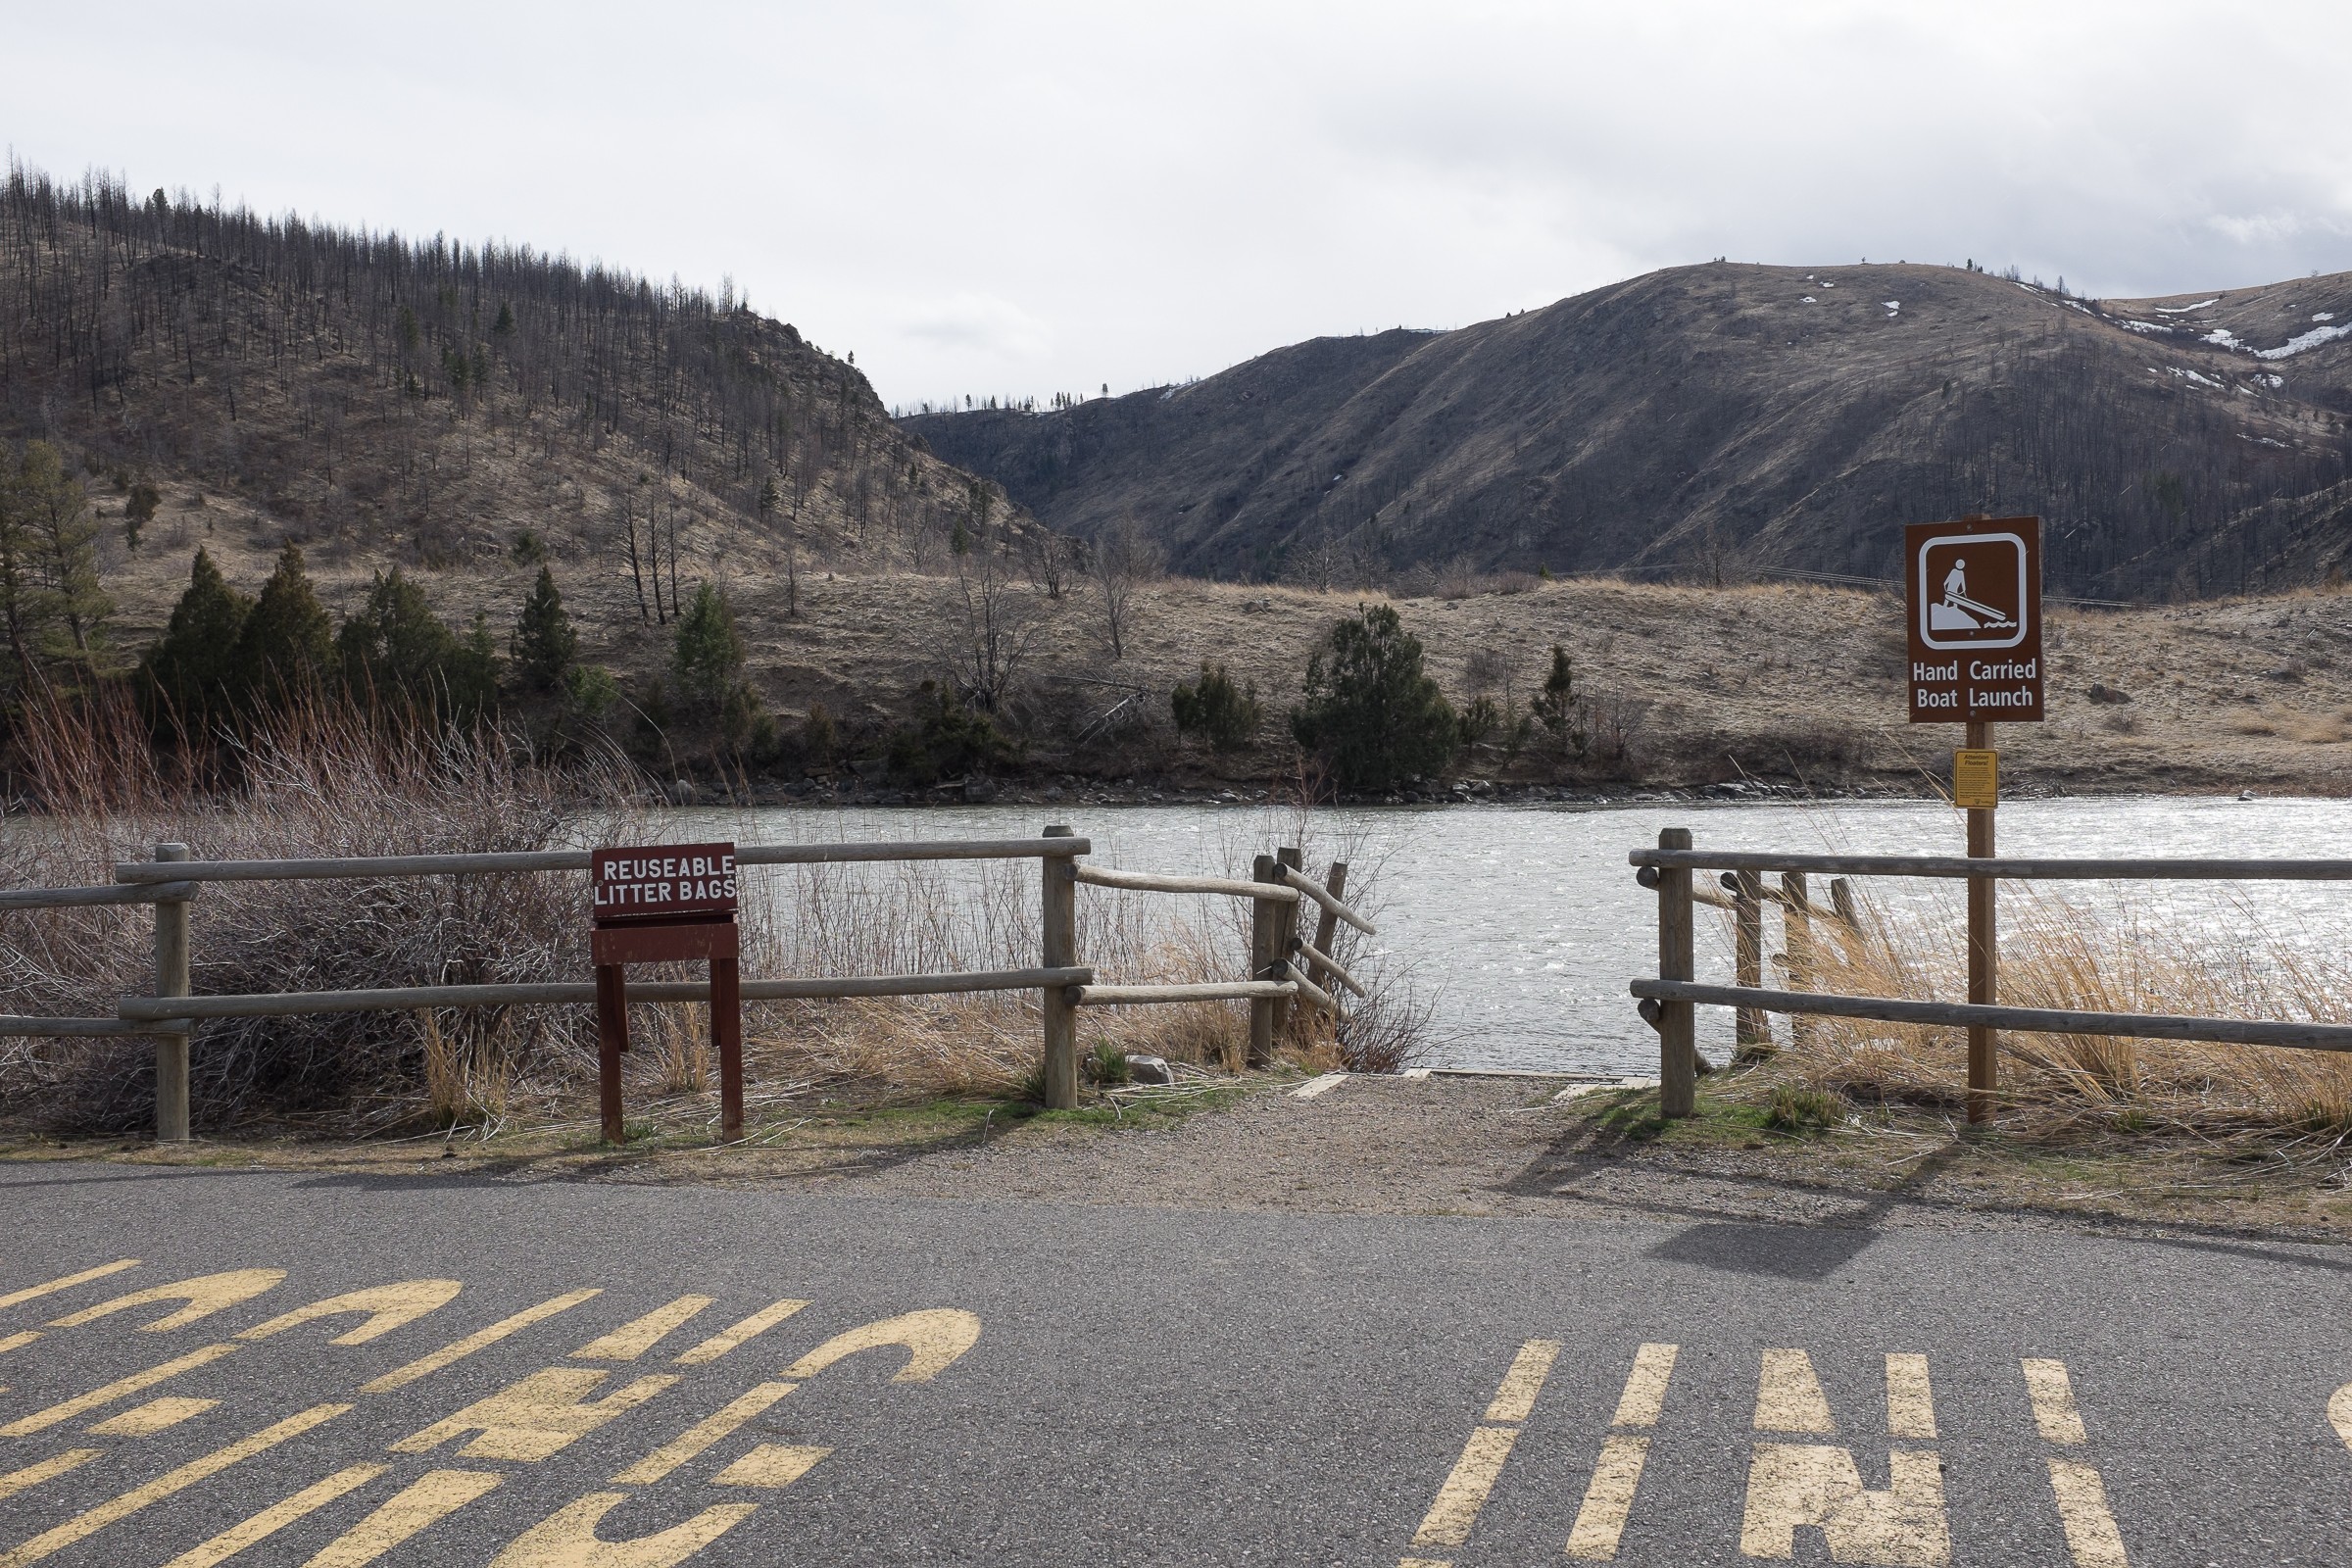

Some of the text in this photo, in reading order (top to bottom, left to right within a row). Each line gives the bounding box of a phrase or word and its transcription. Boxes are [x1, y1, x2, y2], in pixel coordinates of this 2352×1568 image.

[1913, 658, 2036, 681] Hand Carried
[1917, 685, 2034, 708] Boat Launch
[604, 855, 735, 881] REUSEABLE
[594, 878, 737, 906] LITTER BAGS
